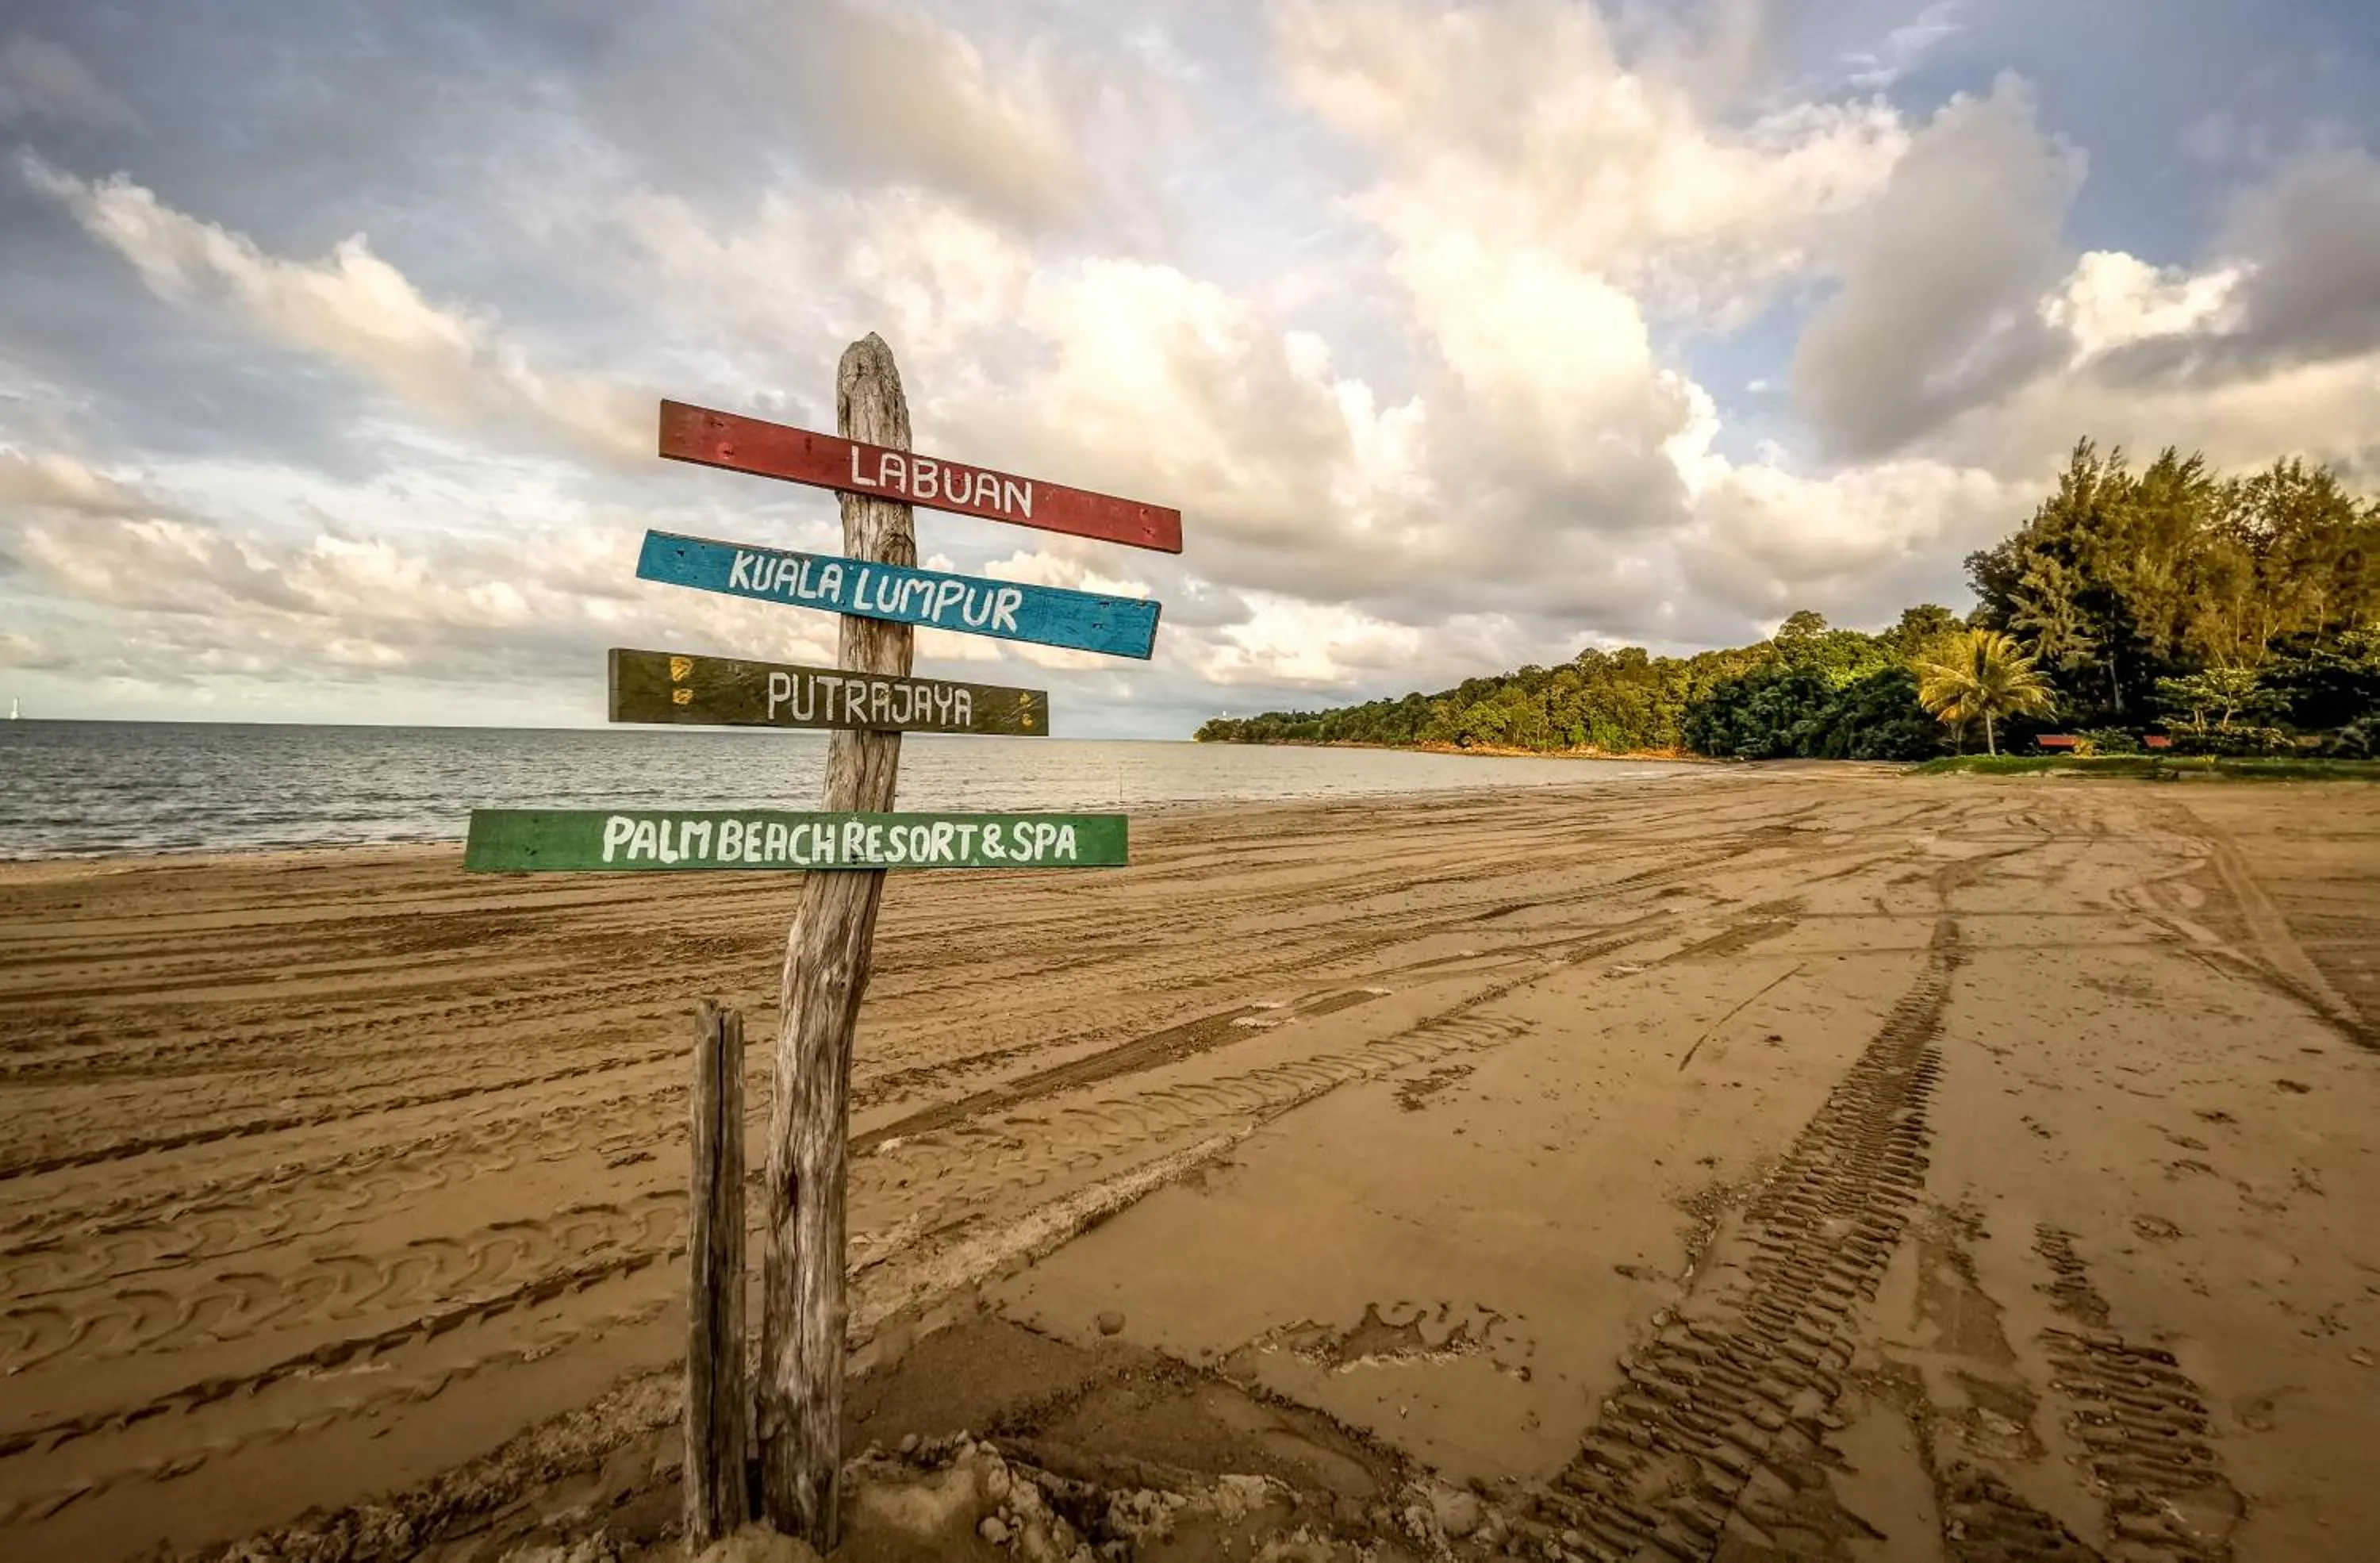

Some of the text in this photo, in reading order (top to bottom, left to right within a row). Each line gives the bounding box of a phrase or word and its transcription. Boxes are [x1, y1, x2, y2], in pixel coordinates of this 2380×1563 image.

[850, 445, 1032, 518] LABUAN
[728, 549, 1023, 632] KUALA LUMPUR
[766, 671, 973, 727] PUTRAJAYA
[601, 814, 1077, 865] PALM BEACH RESORT & SPA
